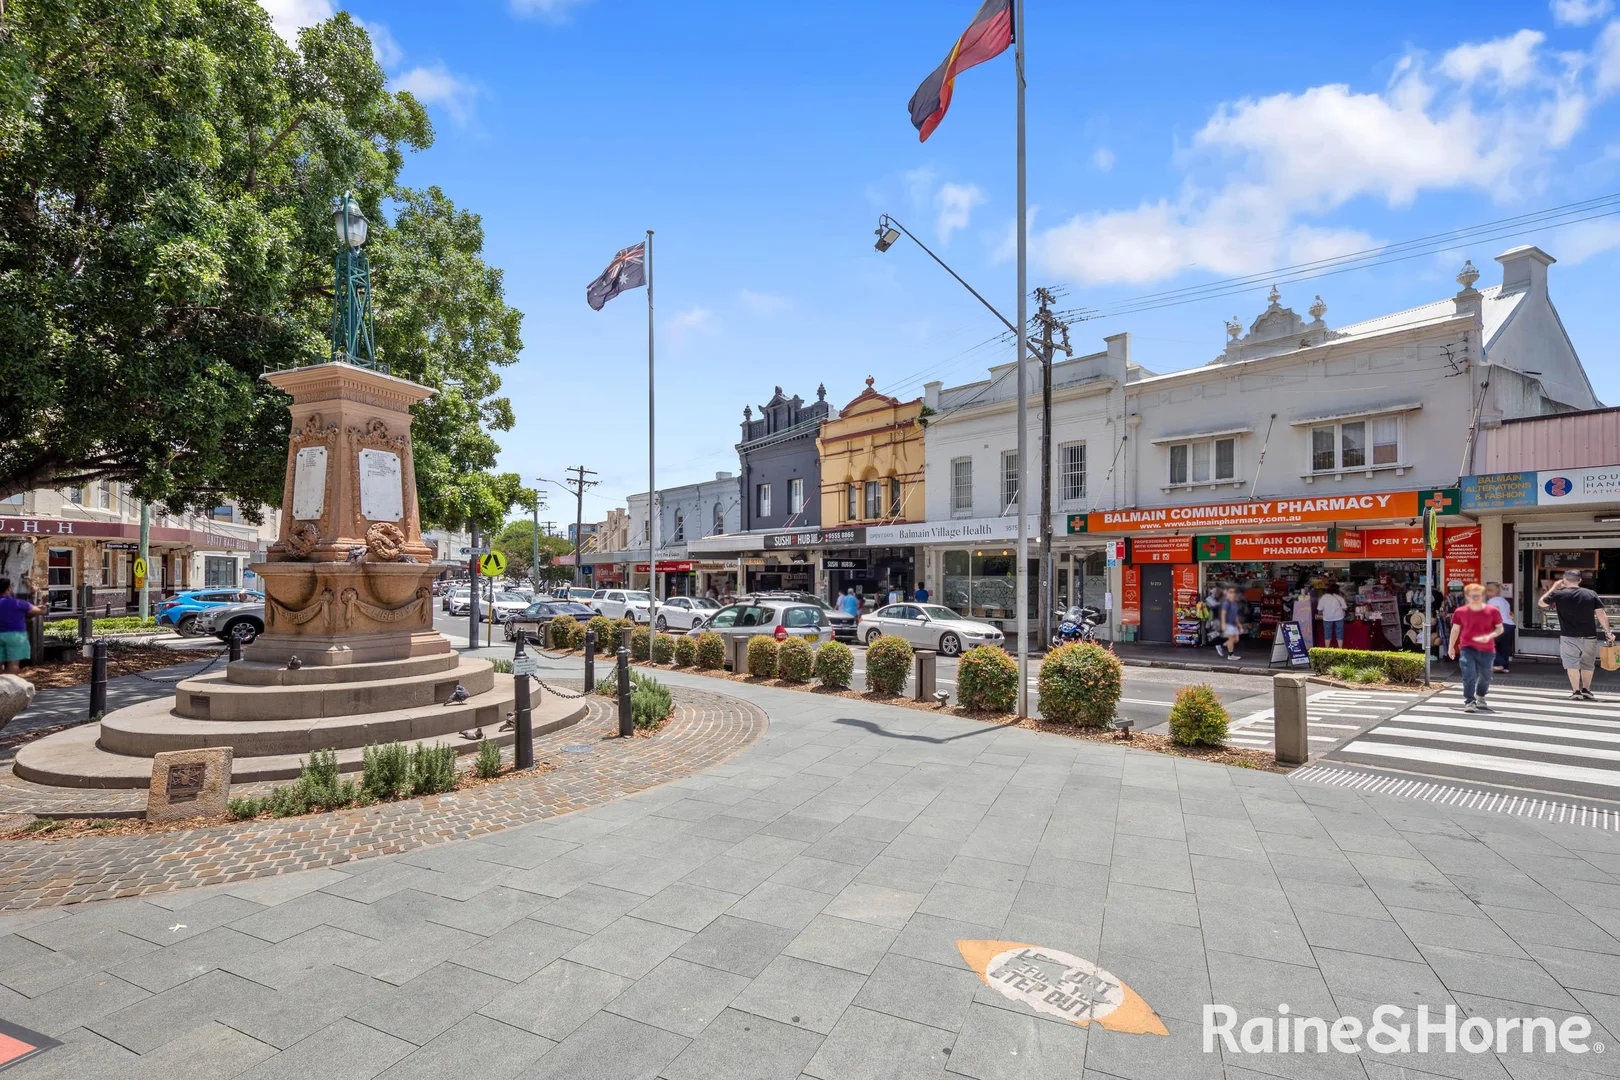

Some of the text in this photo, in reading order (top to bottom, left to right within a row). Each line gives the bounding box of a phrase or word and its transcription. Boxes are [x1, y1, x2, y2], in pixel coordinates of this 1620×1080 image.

[1478, 475, 1522, 483] BALMAIN
[1466, 482, 1531, 492] ALTERATIONS
[1485, 491, 1525, 499] FASHION
[1104, 495, 1391, 523] BALMAIN COMMUNITY PHARMACY
[1164, 516, 1301, 527] www.balmainpharmacy.com.au
[899, 524, 992, 539] Balmain Village Health
[774, 535, 792, 546] SUSHI
[797, 534, 811, 544] HUB
[1286, 535, 1328, 544] COMMU
[1263, 546, 1326, 555] PHARMACY
[372, 605, 414, 620] LIBERTY
[1043, 989, 1091, 1017] OUT
